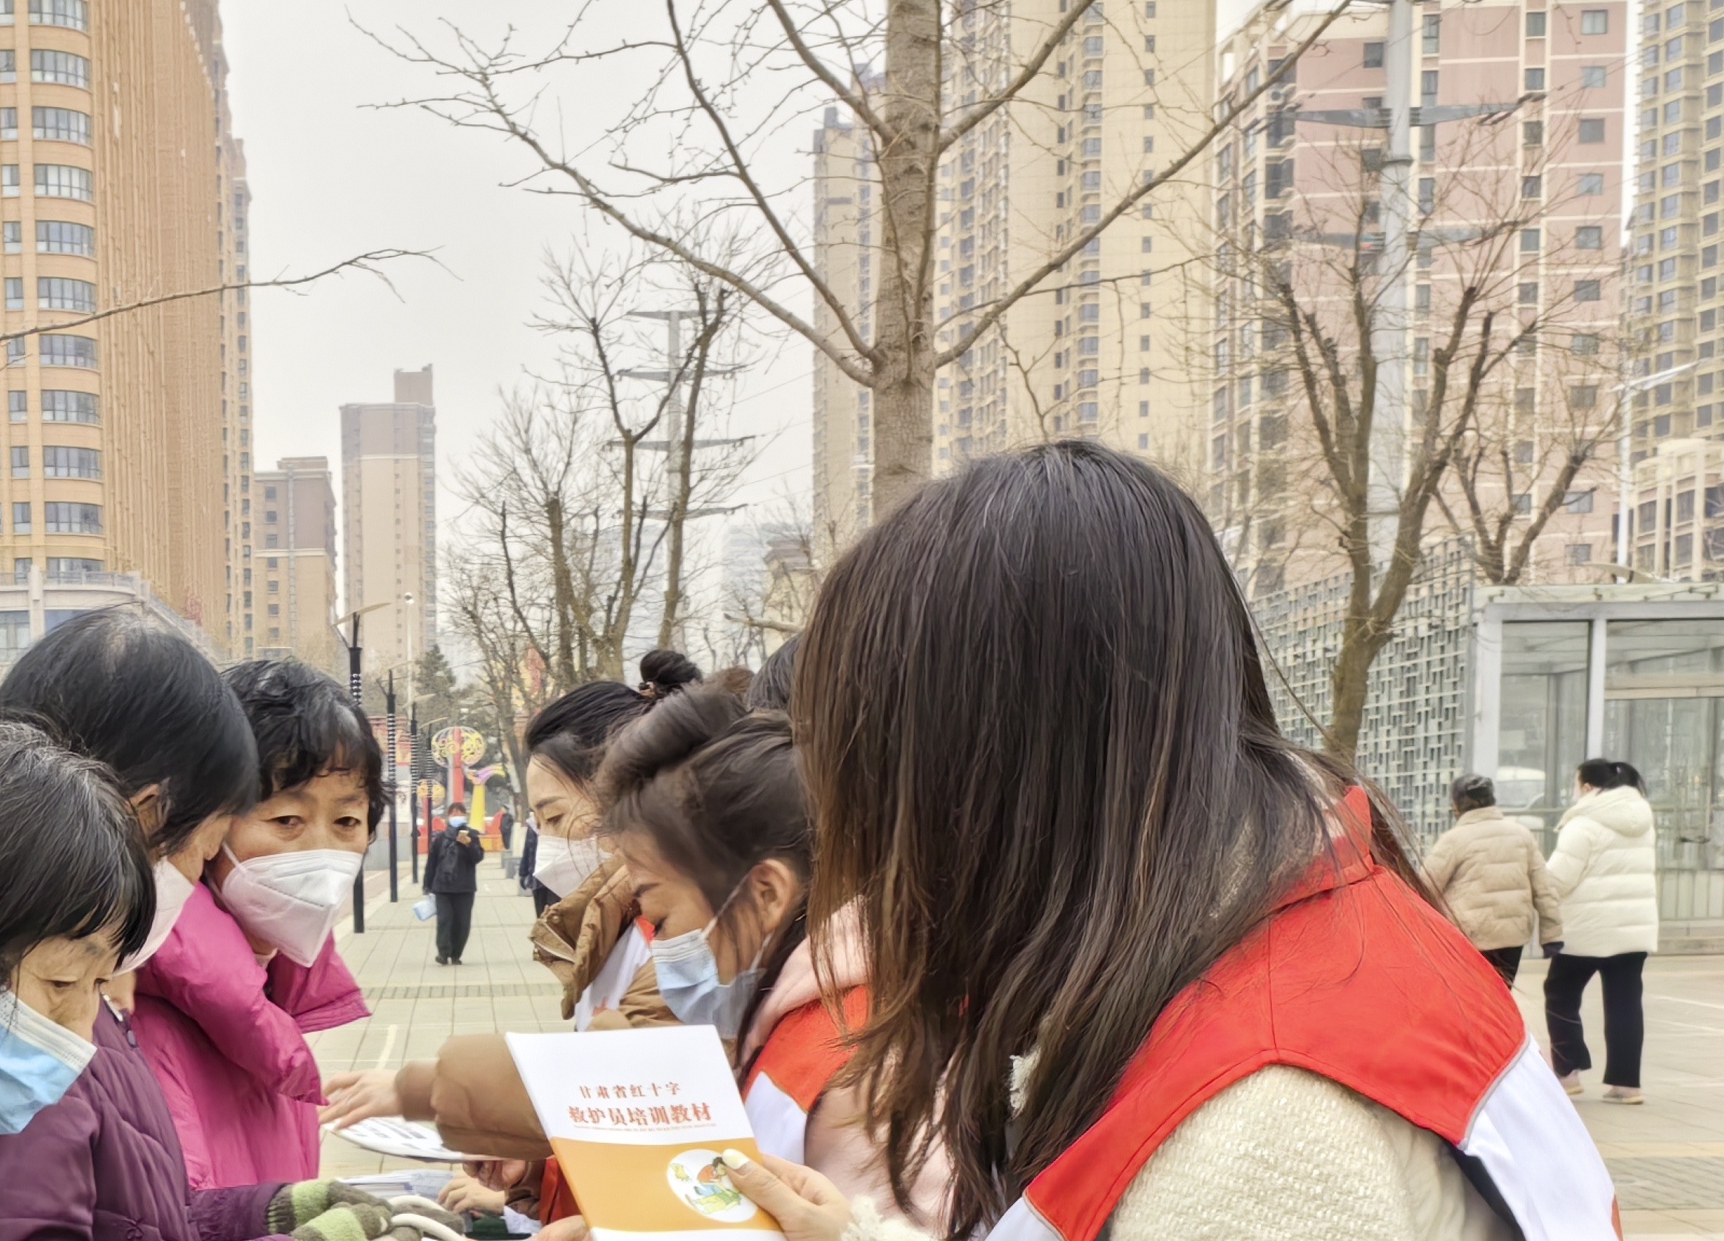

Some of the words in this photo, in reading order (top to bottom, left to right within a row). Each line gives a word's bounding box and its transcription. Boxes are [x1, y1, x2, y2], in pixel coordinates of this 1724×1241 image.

[578, 1081, 681, 1100] 甘肃省红十字
[568, 1101, 713, 1127] 救护员培训教材
